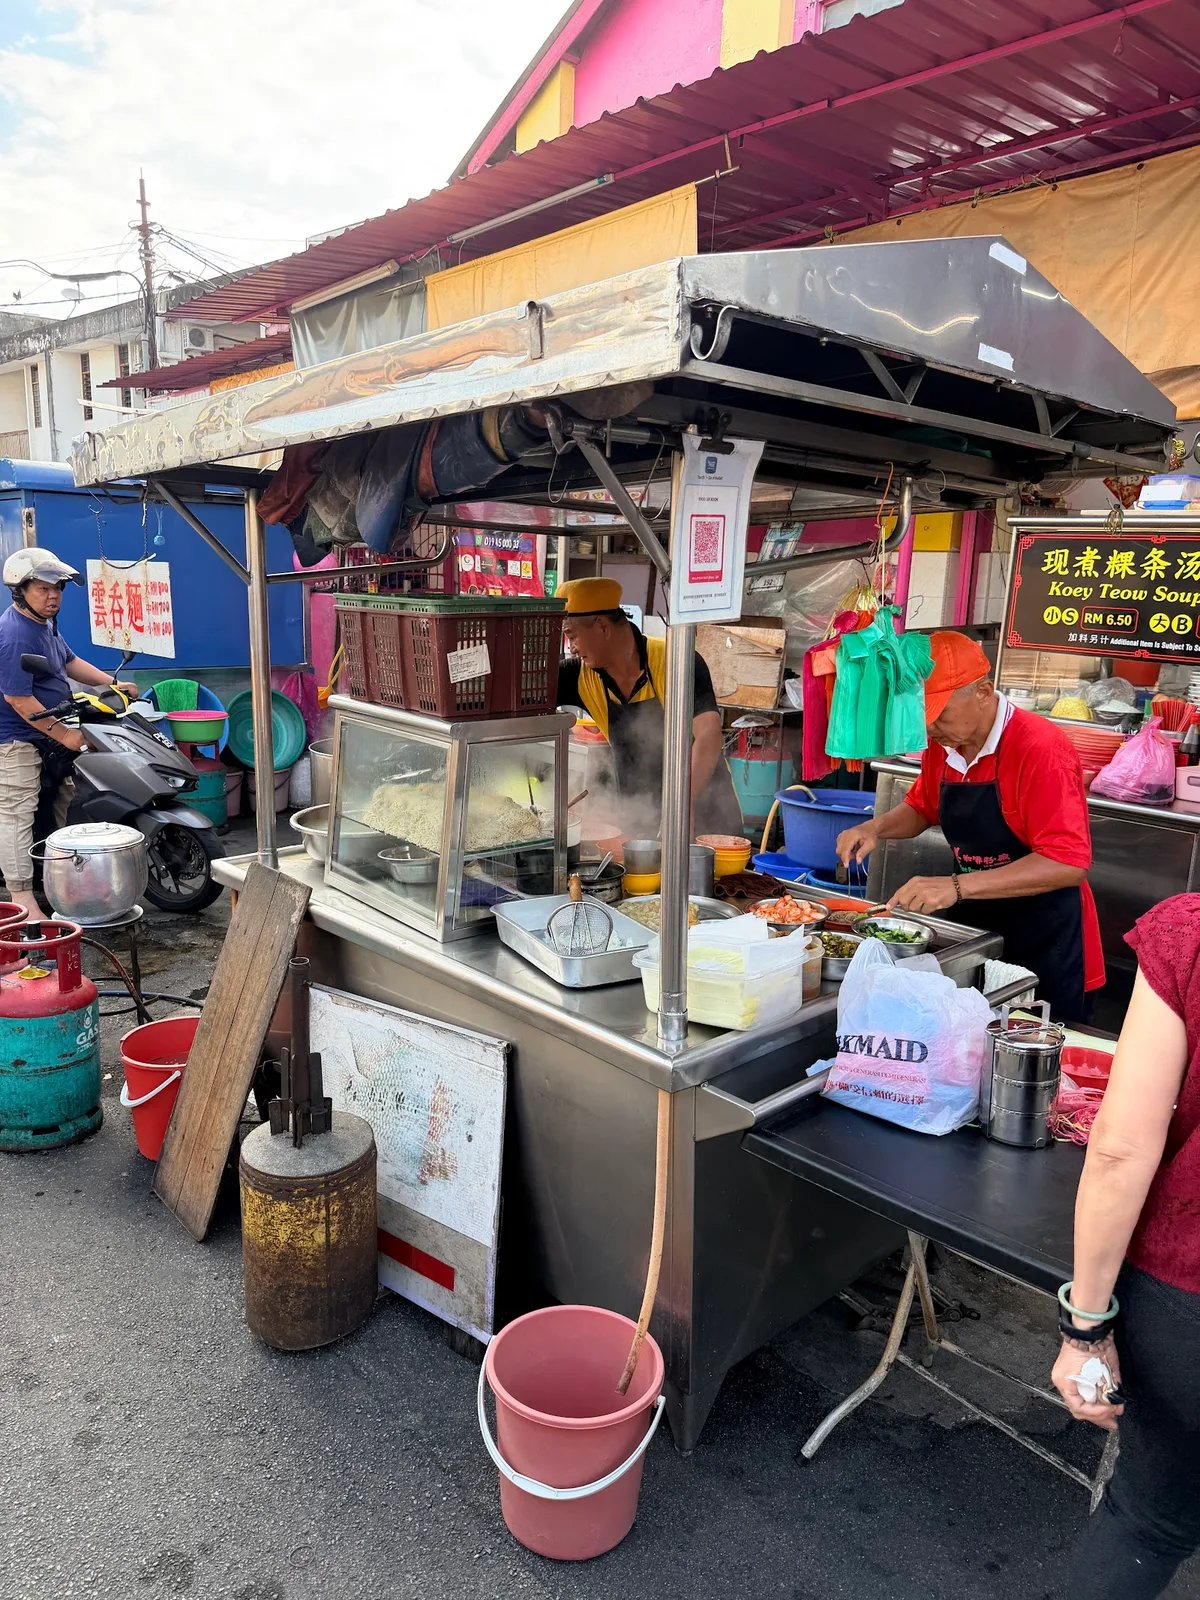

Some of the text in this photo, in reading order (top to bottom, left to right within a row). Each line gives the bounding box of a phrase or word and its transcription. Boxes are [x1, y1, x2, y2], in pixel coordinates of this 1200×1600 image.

[1041, 546, 1200, 581] 现煮粿条汤
[91, 580, 145, 633] 雲吞麵
[1048, 581, 1200, 607] Koey Teow Soup
[1084, 612, 1103, 625] RM
[1106, 614, 1132, 627] 6.50
[1067, 632, 1109, 644] 加料另计
[1110, 637, 1139, 647] Additional
[1139, 639, 1153, 648] Item
[1161, 641, 1185, 651] Subject
[1185, 642, 1194, 651] To
